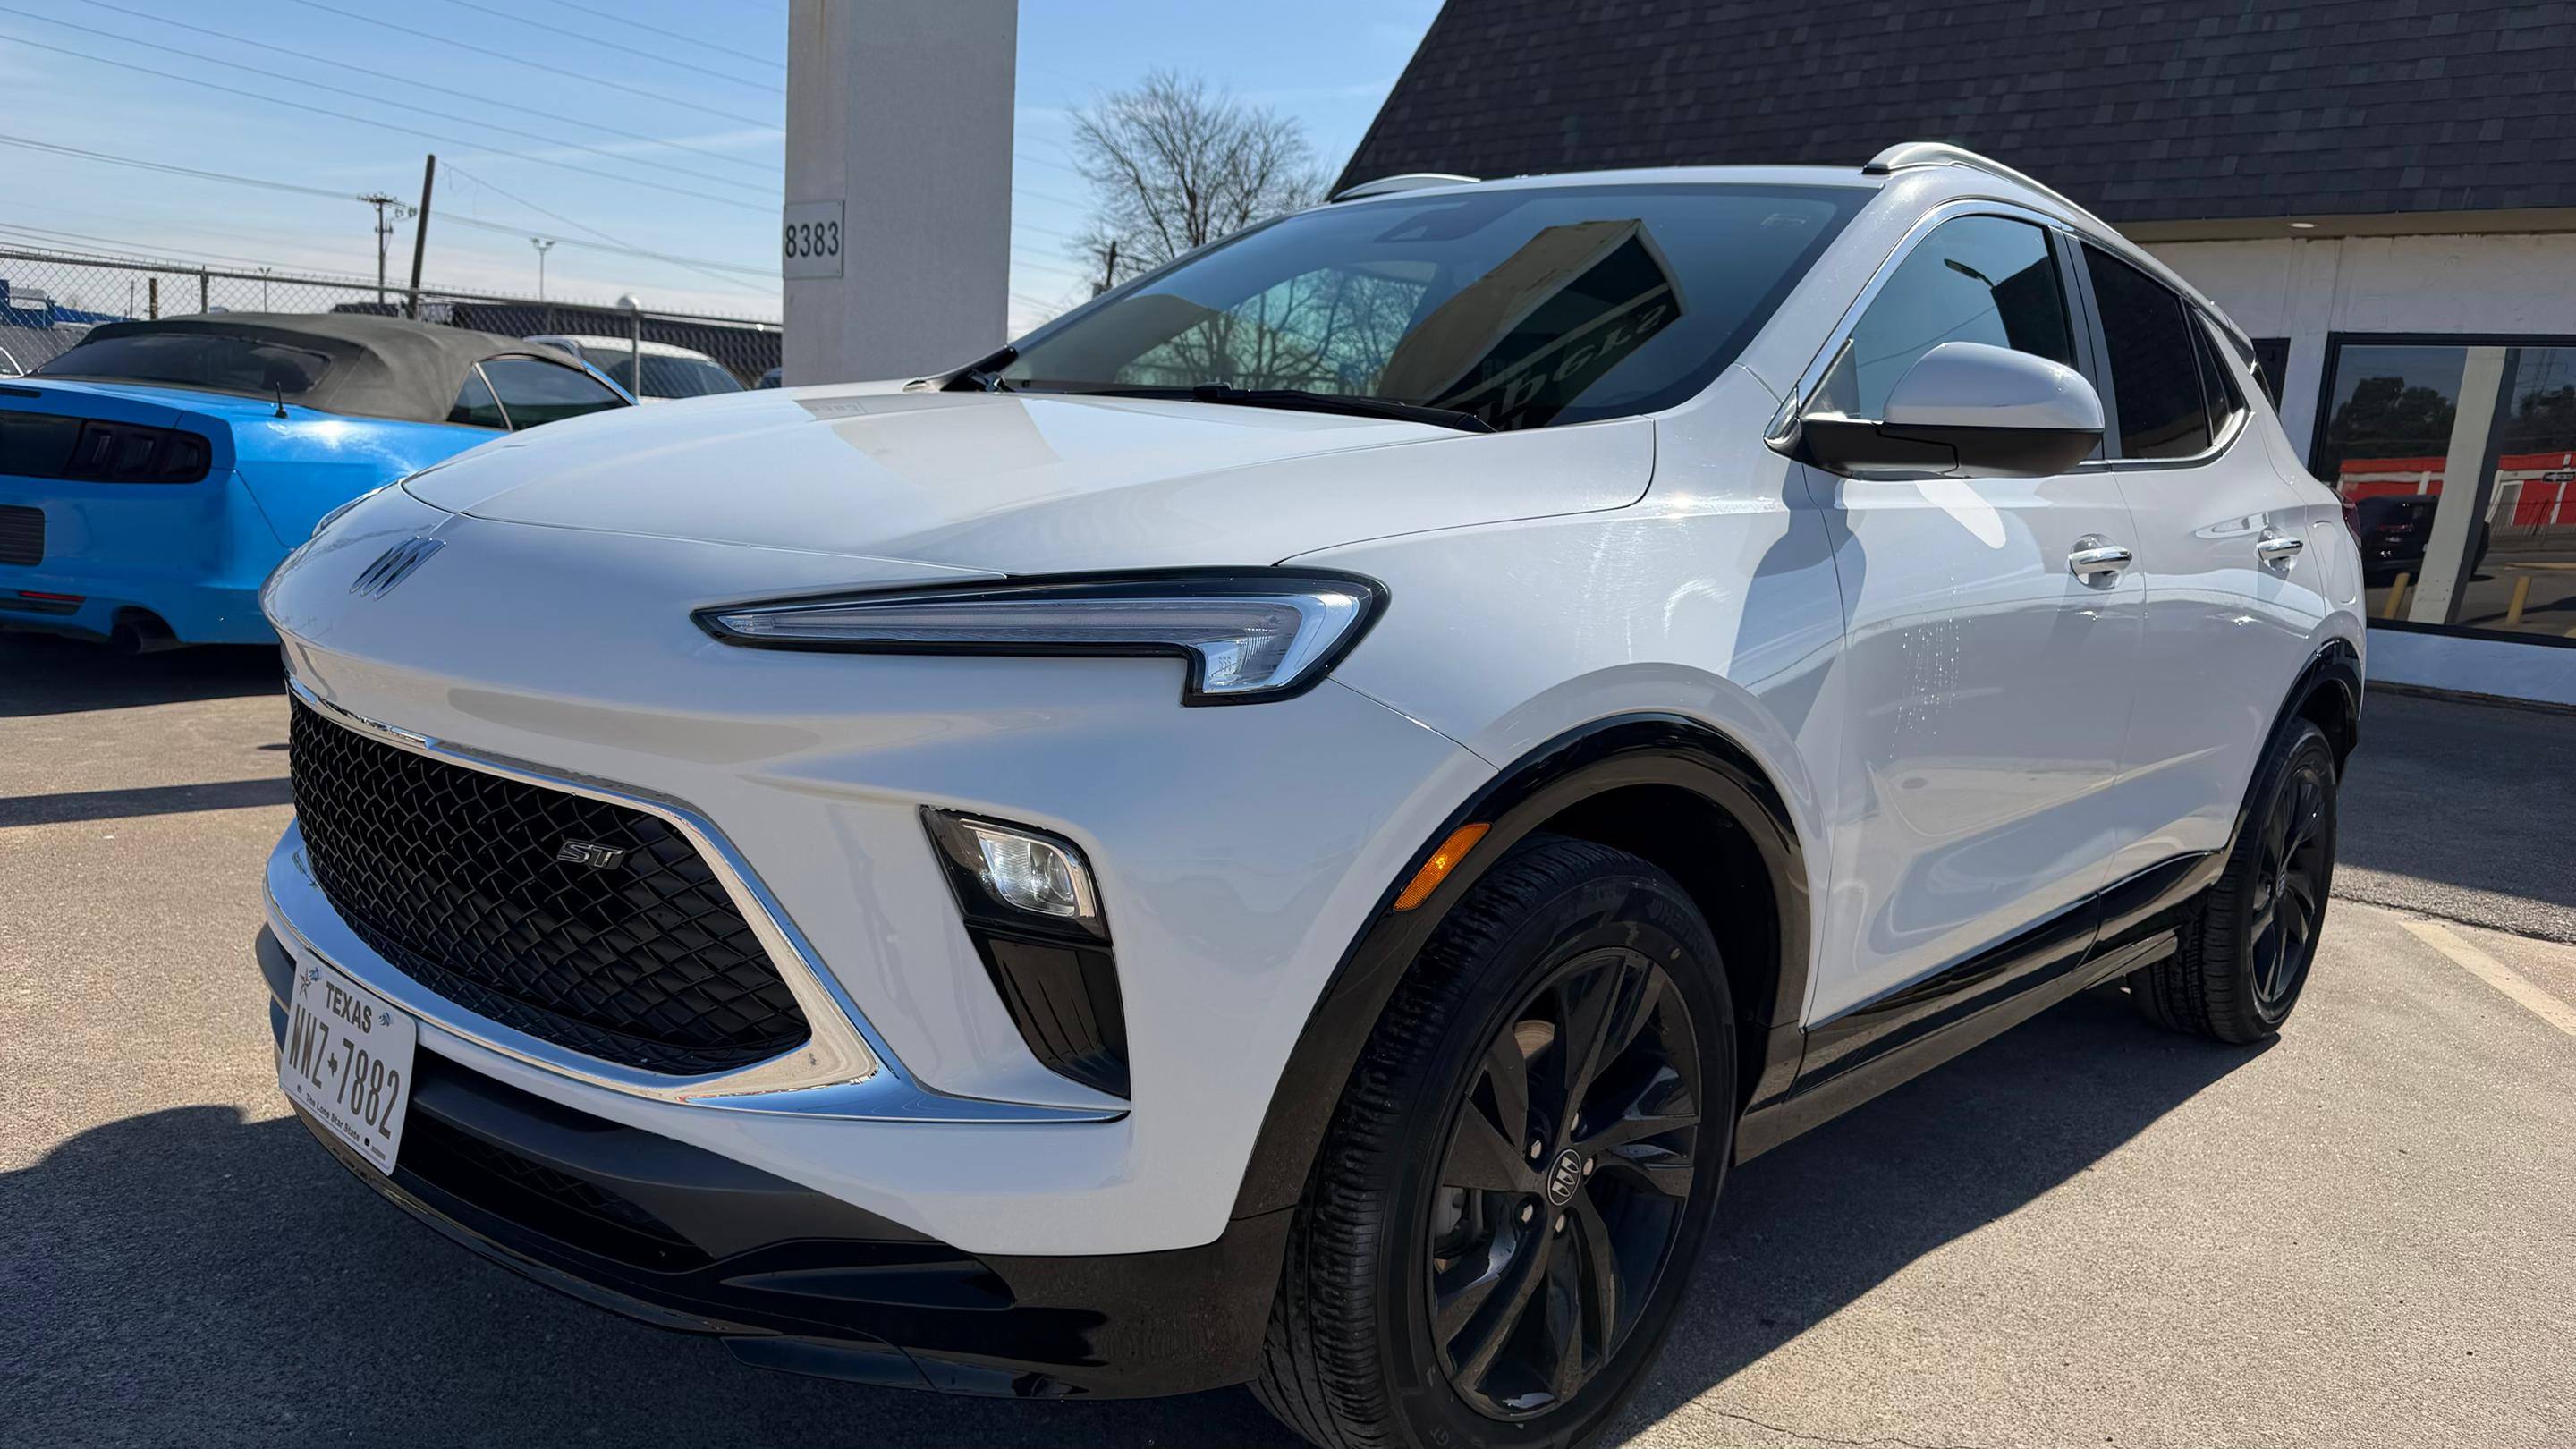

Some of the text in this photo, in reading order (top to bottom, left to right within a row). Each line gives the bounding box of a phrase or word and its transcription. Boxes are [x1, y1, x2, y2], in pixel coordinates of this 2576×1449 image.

[786, 221, 839, 258] 8383
[557, 841, 623, 868] ST
[326, 981, 372, 1033] TEXAS
[337, 1037, 400, 1140] 7882
[306, 1092, 360, 1141] The Lone Star State
